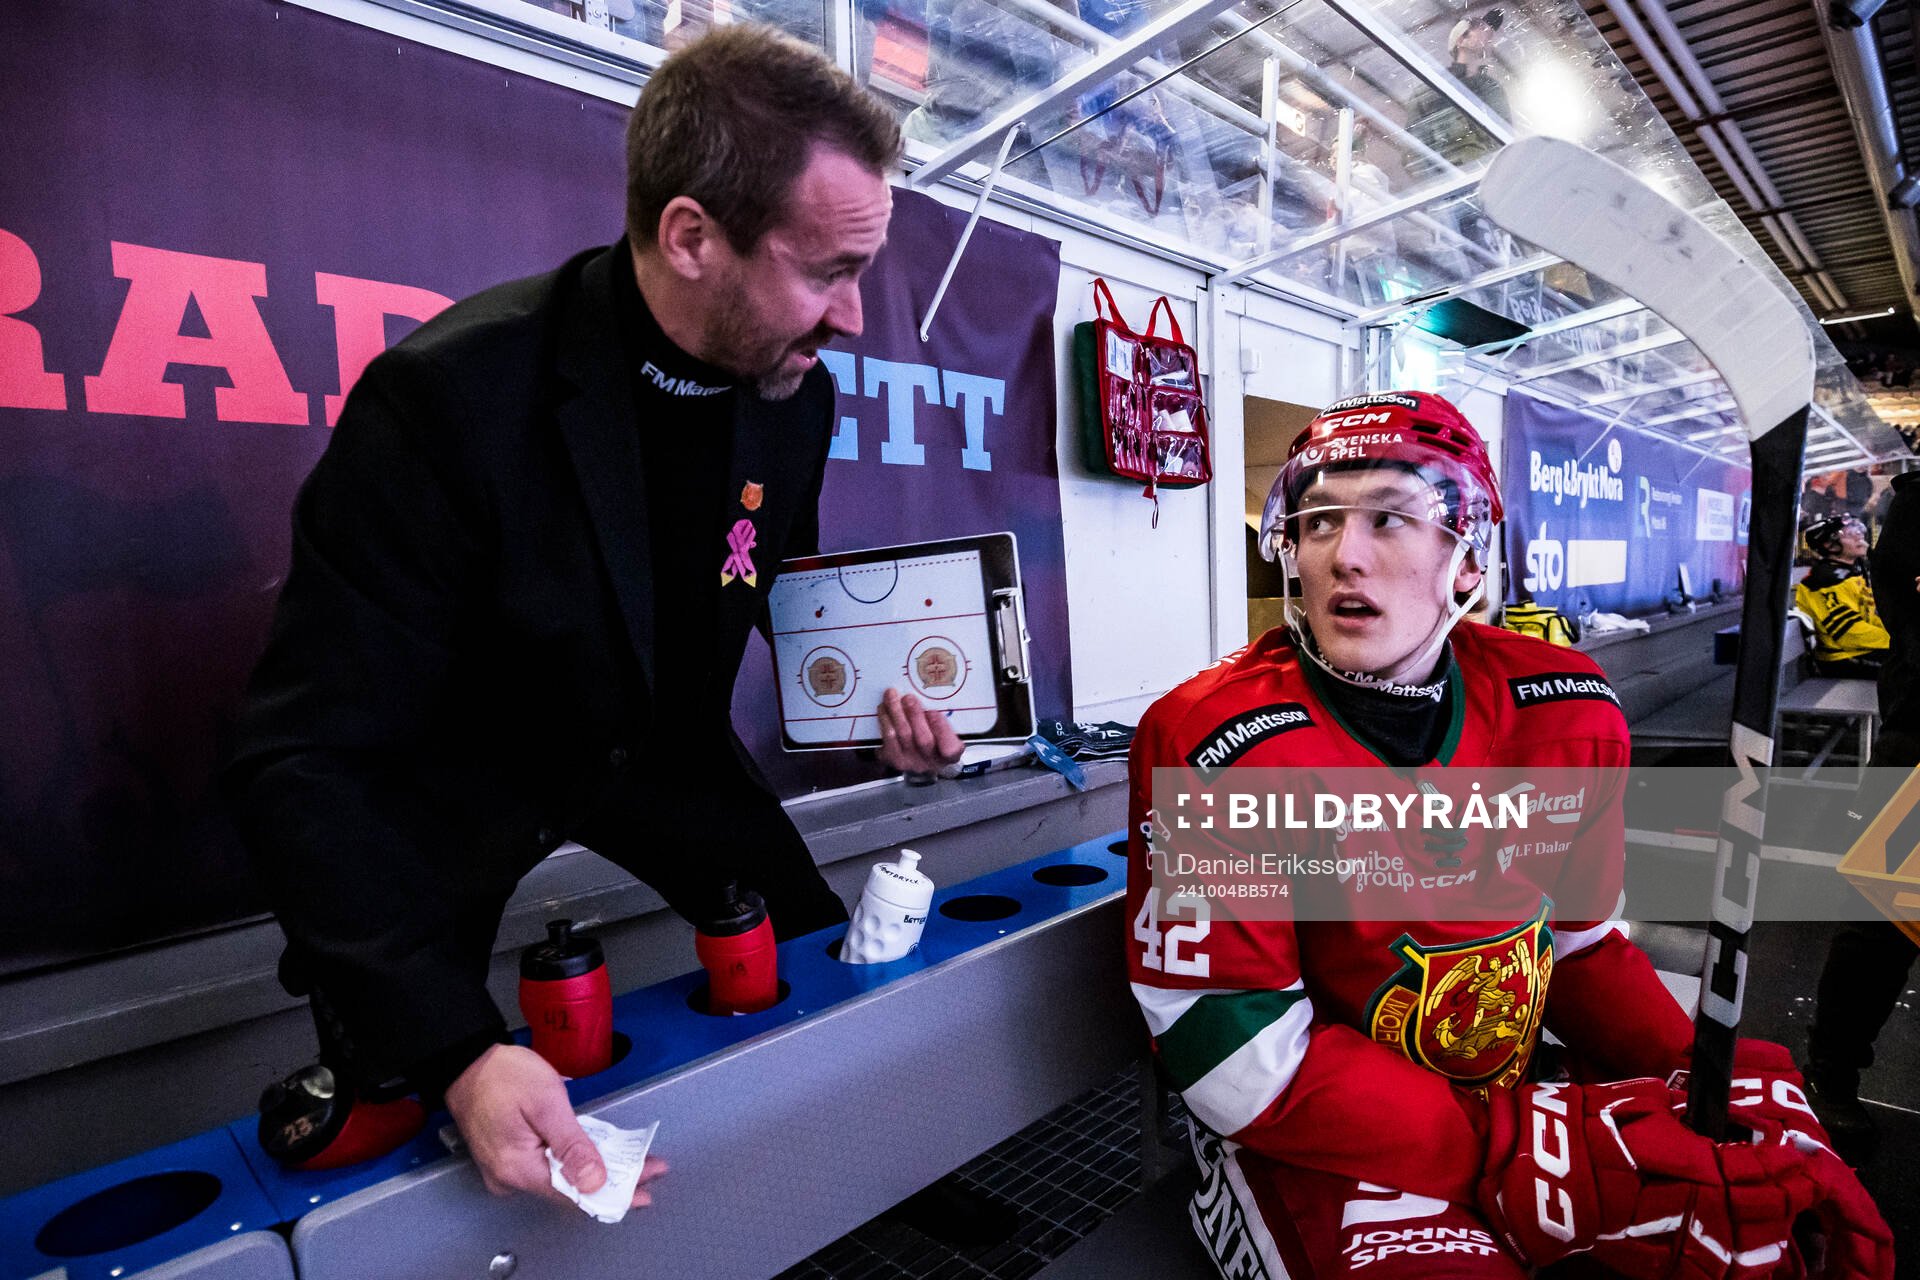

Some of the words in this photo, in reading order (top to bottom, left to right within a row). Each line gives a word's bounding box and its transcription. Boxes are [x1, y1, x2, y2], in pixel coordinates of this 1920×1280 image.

[640, 360, 677, 393] FM
[1329, 446, 1367, 461] SPEL
[1517, 682, 1551, 701] FM
[1196, 737, 1232, 774] FM
[1224, 710, 1311, 749] Mattsson
[1356, 871, 1415, 893] group
[1419, 869, 1477, 889] CCM
[1133, 886, 1212, 979] 42
[1376, 996, 1410, 1047] MOR
[1531, 1081, 1576, 1243] CCM
[1342, 1227, 1494, 1255] JOHNS
[1348, 1240, 1499, 1270] SPORT
